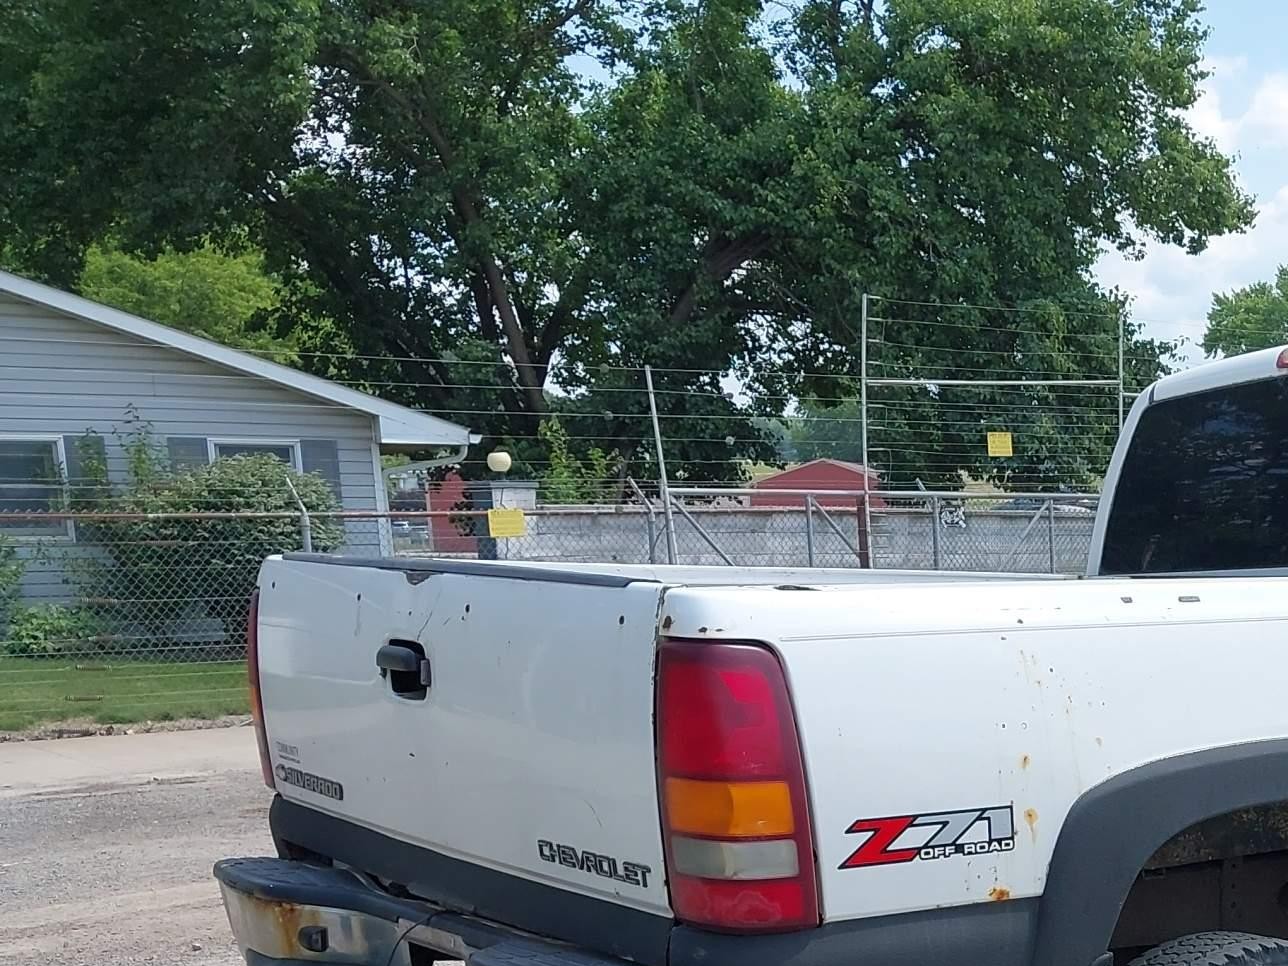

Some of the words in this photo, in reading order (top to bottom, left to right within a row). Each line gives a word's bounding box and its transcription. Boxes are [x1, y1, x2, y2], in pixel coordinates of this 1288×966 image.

[285, 768, 342, 800] SILVERADO
[837, 805, 1015, 870] Z71
[919, 845, 956, 861] OFF
[962, 839, 1015, 857] ROAD
[536, 838, 652, 889] CHEVROLET
